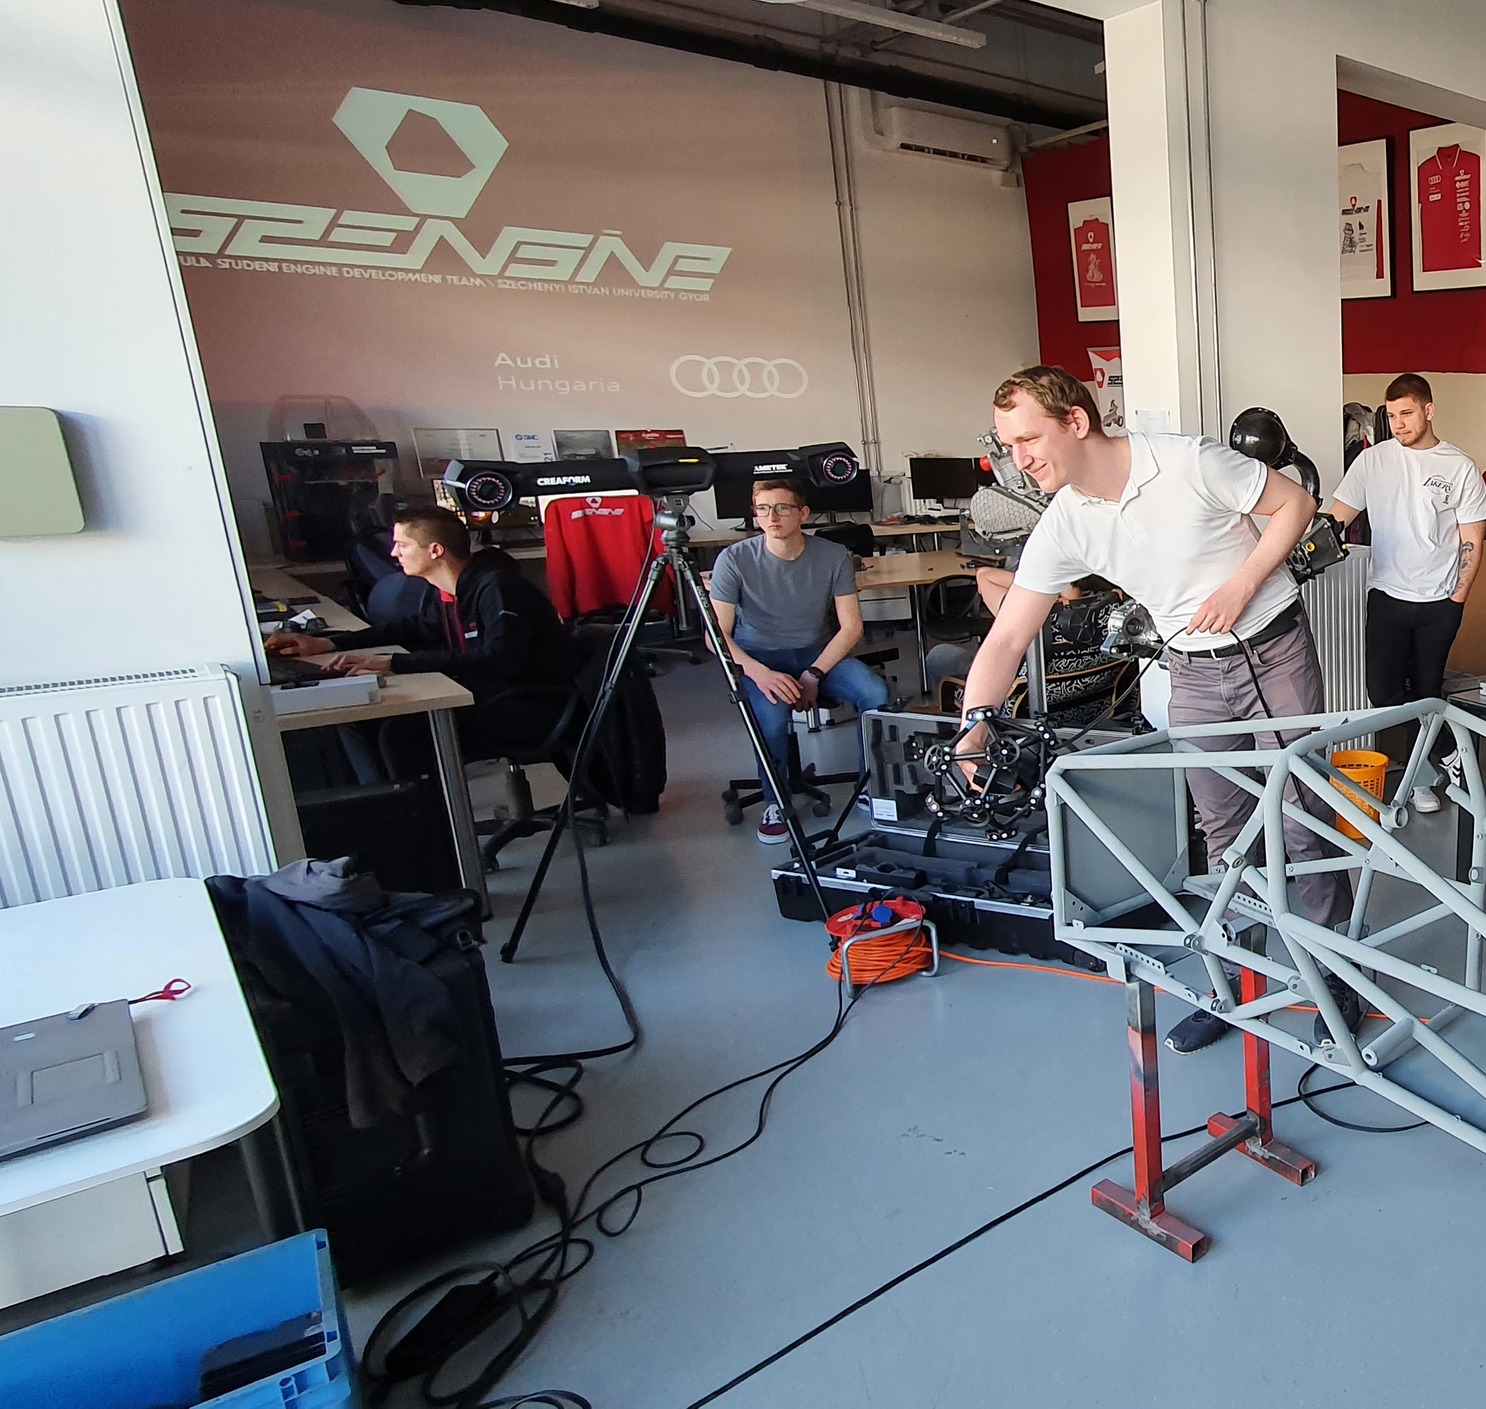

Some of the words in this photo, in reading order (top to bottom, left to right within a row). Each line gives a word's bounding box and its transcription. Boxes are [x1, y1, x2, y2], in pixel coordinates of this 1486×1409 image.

[179, 255, 213, 268] ULA
[216, 258, 279, 273] STUDENT
[281, 262, 340, 278] ENGINE
[342, 267, 443, 285] DEVELOPMENT
[445, 275, 486, 288] TEAM
[612, 287, 676, 302] UNIVERSITY
[494, 352, 559, 369] Audi
[498, 375, 620, 395] Hungaria
[536, 475, 591, 487] CREAFORM
